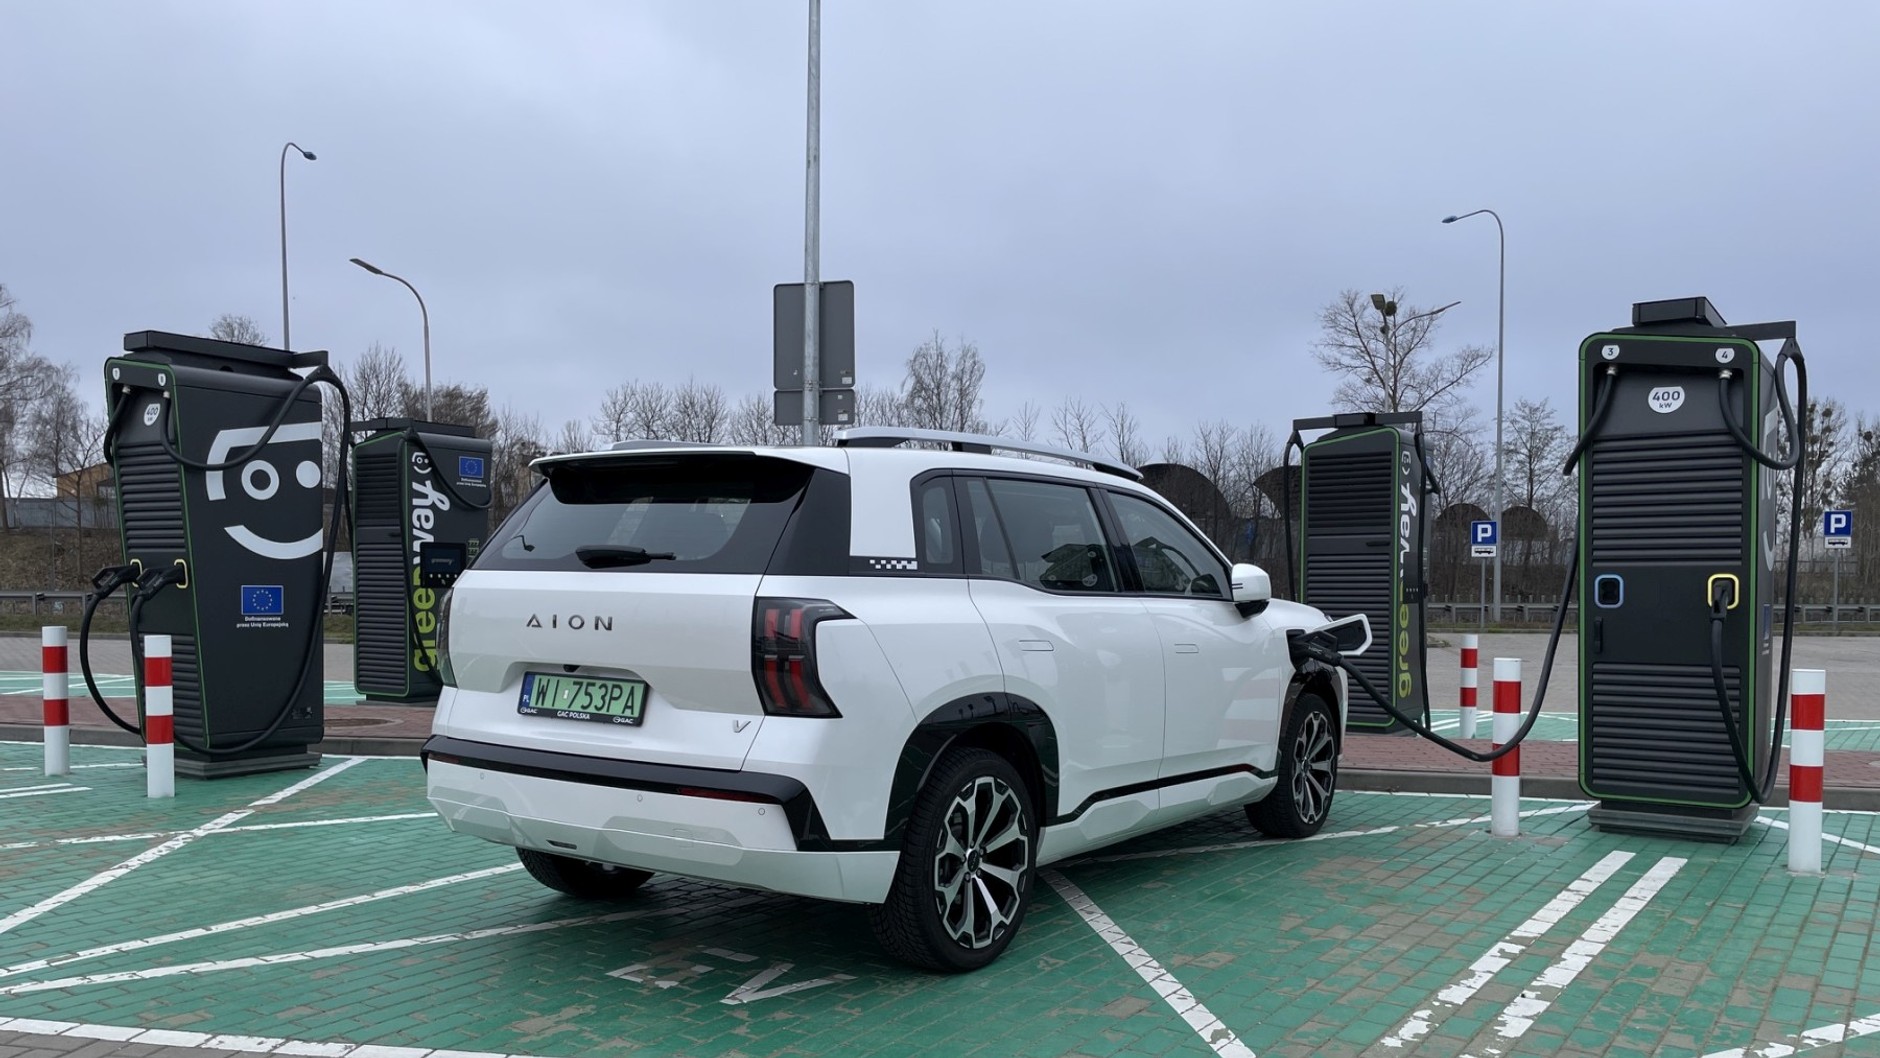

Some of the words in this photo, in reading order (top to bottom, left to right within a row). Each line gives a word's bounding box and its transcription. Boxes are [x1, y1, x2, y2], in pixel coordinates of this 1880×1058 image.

[1607, 347, 1614, 356] 3
[1721, 350, 1728, 359] 4
[1652, 390, 1681, 402] 400
[1830, 513, 1846, 533] P
[1477, 524, 1492, 542] P
[1399, 482, 1417, 698] greeway
[526, 613, 613, 631] AION
[534, 677, 560, 708] WI
[567, 680, 635, 716] 753PA
[557, 710, 569, 718] GAC
